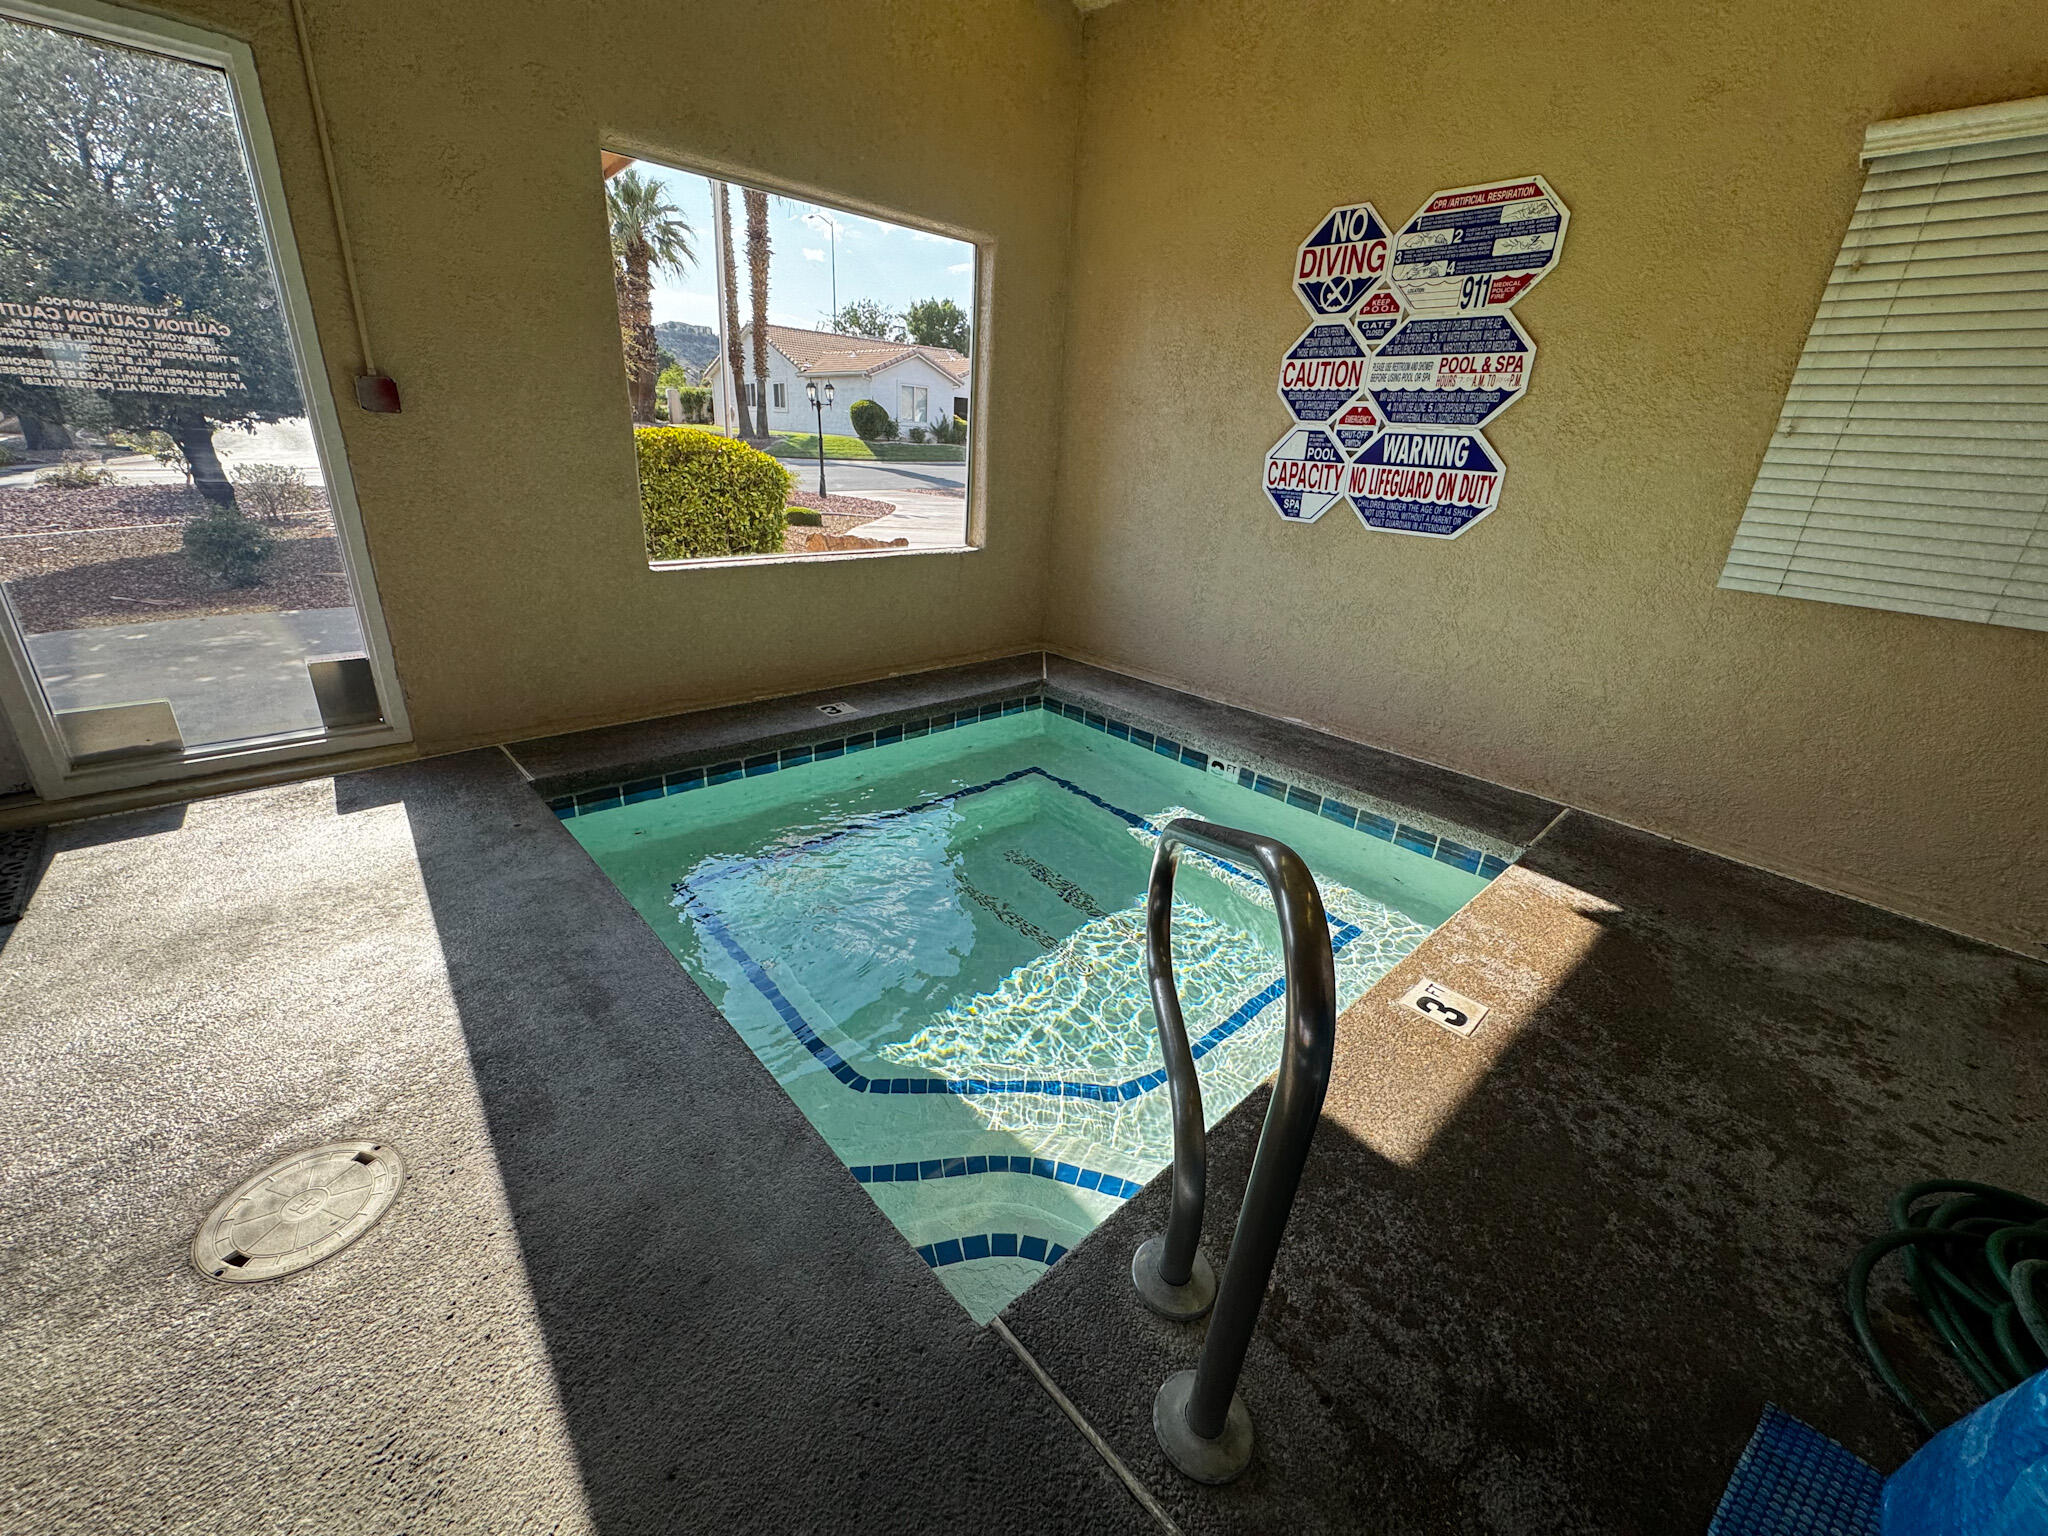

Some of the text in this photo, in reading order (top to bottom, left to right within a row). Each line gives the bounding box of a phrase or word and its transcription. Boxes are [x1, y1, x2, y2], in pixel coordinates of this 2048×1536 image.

[1432, 199, 1448, 210] CPR
[1487, 186, 1536, 202] RESPIRATION
[1330, 207, 1369, 243] NO
[1416, 216, 1422, 231] 1
[1453, 229, 1464, 243] 2
[1299, 240, 1387, 279] DIVING
[1395, 251, 1402, 265] 3
[1447, 260, 1456, 275] 4
[1493, 280, 1521, 288] MEDICAL
[1460, 274, 1493, 310] 911
[1363, 305, 1396, 314] POOL
[1372, 298, 1391, 307] KEEP
[1362, 321, 1392, 330] GATE
[1366, 329, 1384, 337] CLOSED
[1438, 355, 1523, 373] POOL & SPA
[1283, 360, 1364, 388] CAUTION
[1401, 372, 1414, 382] POOL
[1421, 372, 1431, 382] SPA
[1436, 375, 1457, 387] HOURS
[1487, 374, 1496, 386] TO
[1345, 414, 1372, 424] EMERGENCY
[1341, 430, 1369, 440] SHUT-OFF
[1344, 438, 1361, 448] SWITCH
[1307, 447, 1337, 461] POOL
[1382, 434, 1470, 468] WARNING
[1268, 461, 1345, 491] CAPACITY
[1349, 466, 1498, 505] NO LIFEGUARD ON DUTY
[1283, 498, 1300, 510] SPA
[1357, 499, 1474, 519] CHILDREN UNDER THE AGE OF 14 SHALL
[1364, 509, 1375, 517] NOT
[1375, 510, 1386, 518] USE
[1386, 510, 1400, 520] POOL
[1400, 512, 1425, 522] WITHOUT
[1430, 514, 1452, 525] PARENT
[1452, 517, 1462, 526] OR
[1369, 517, 1385, 527] ADULT
[1385, 518, 1411, 529] GUARDIAN
[1418, 522, 1453, 534] ATTENDANCE
[821, 705, 842, 715] 3
[1226, 764, 1237, 775] FT
[1416, 983, 1469, 1027] 3 FT
